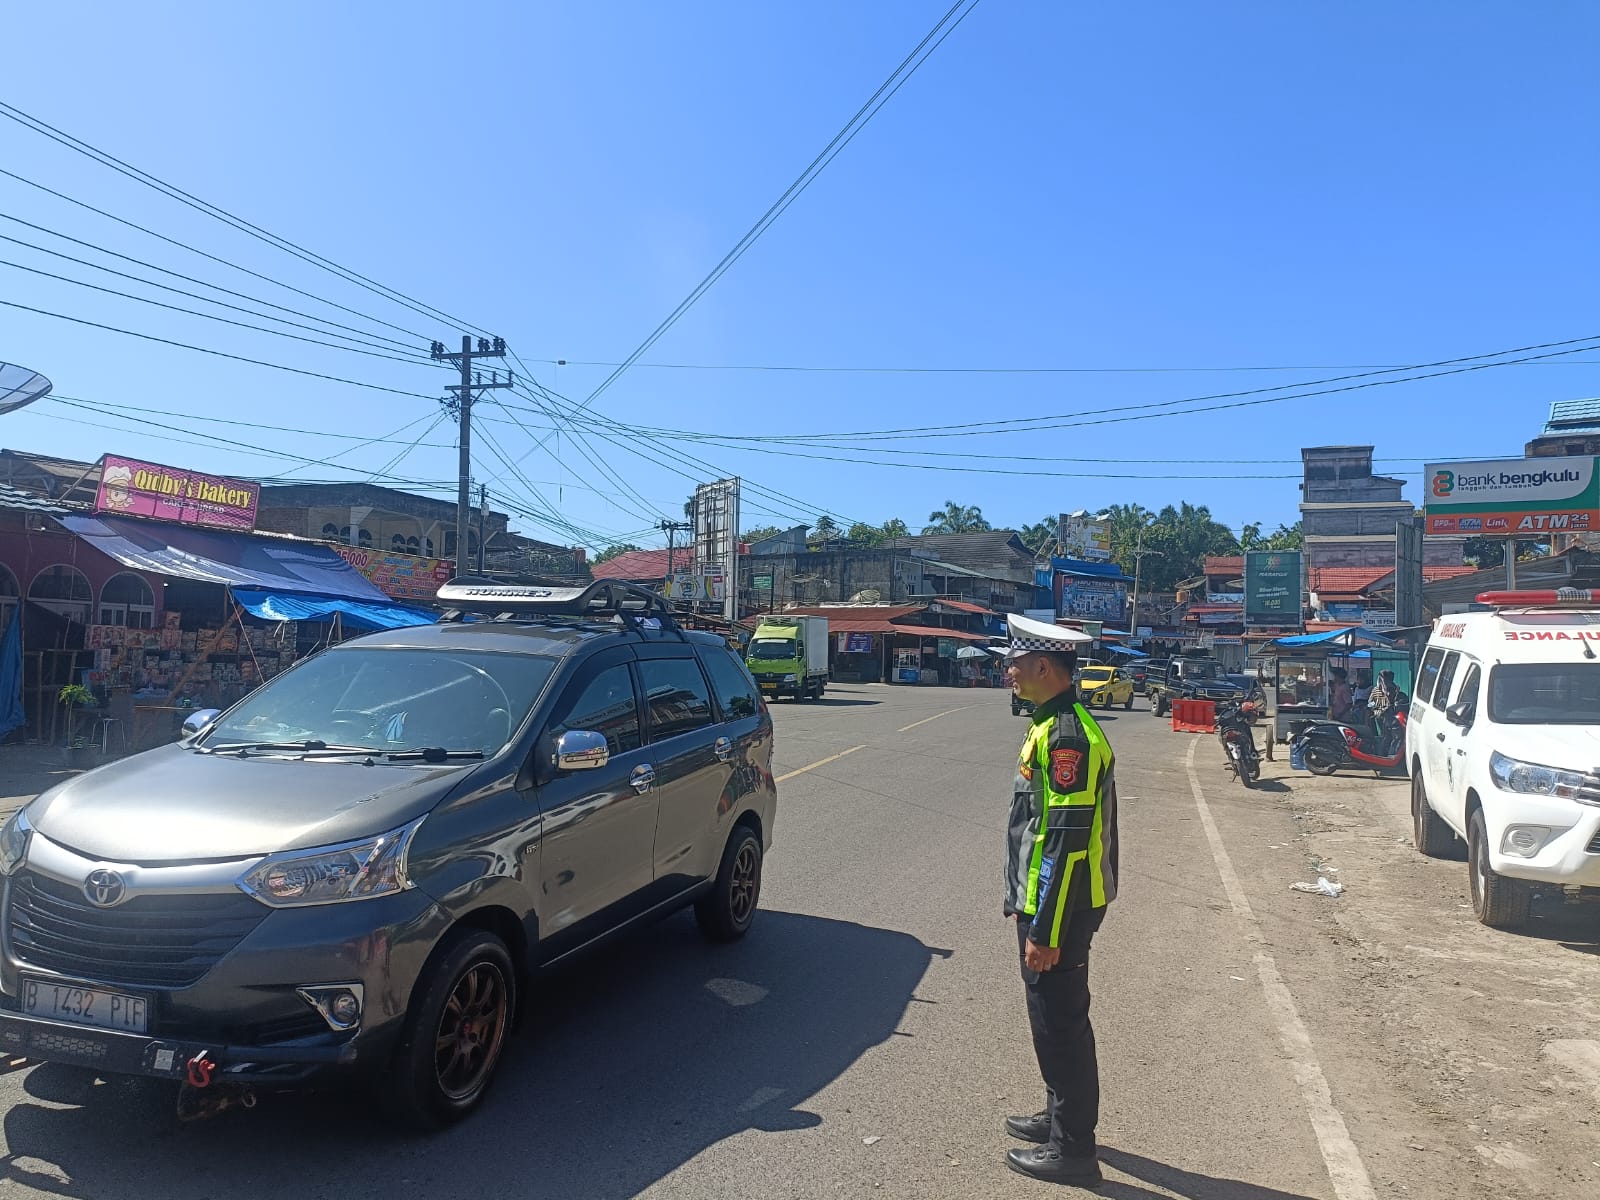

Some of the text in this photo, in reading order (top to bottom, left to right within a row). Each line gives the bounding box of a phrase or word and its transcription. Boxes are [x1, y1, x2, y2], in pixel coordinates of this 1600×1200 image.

[1457, 469, 1580, 486] bank bengkulu
[197, 481, 252, 508] Bakery
[1486, 518, 1508, 528] Link
[1517, 515, 1568, 530] ATM
[1571, 513, 1590, 521] 24
[26, 983, 144, 1027] B 1432 PIF
